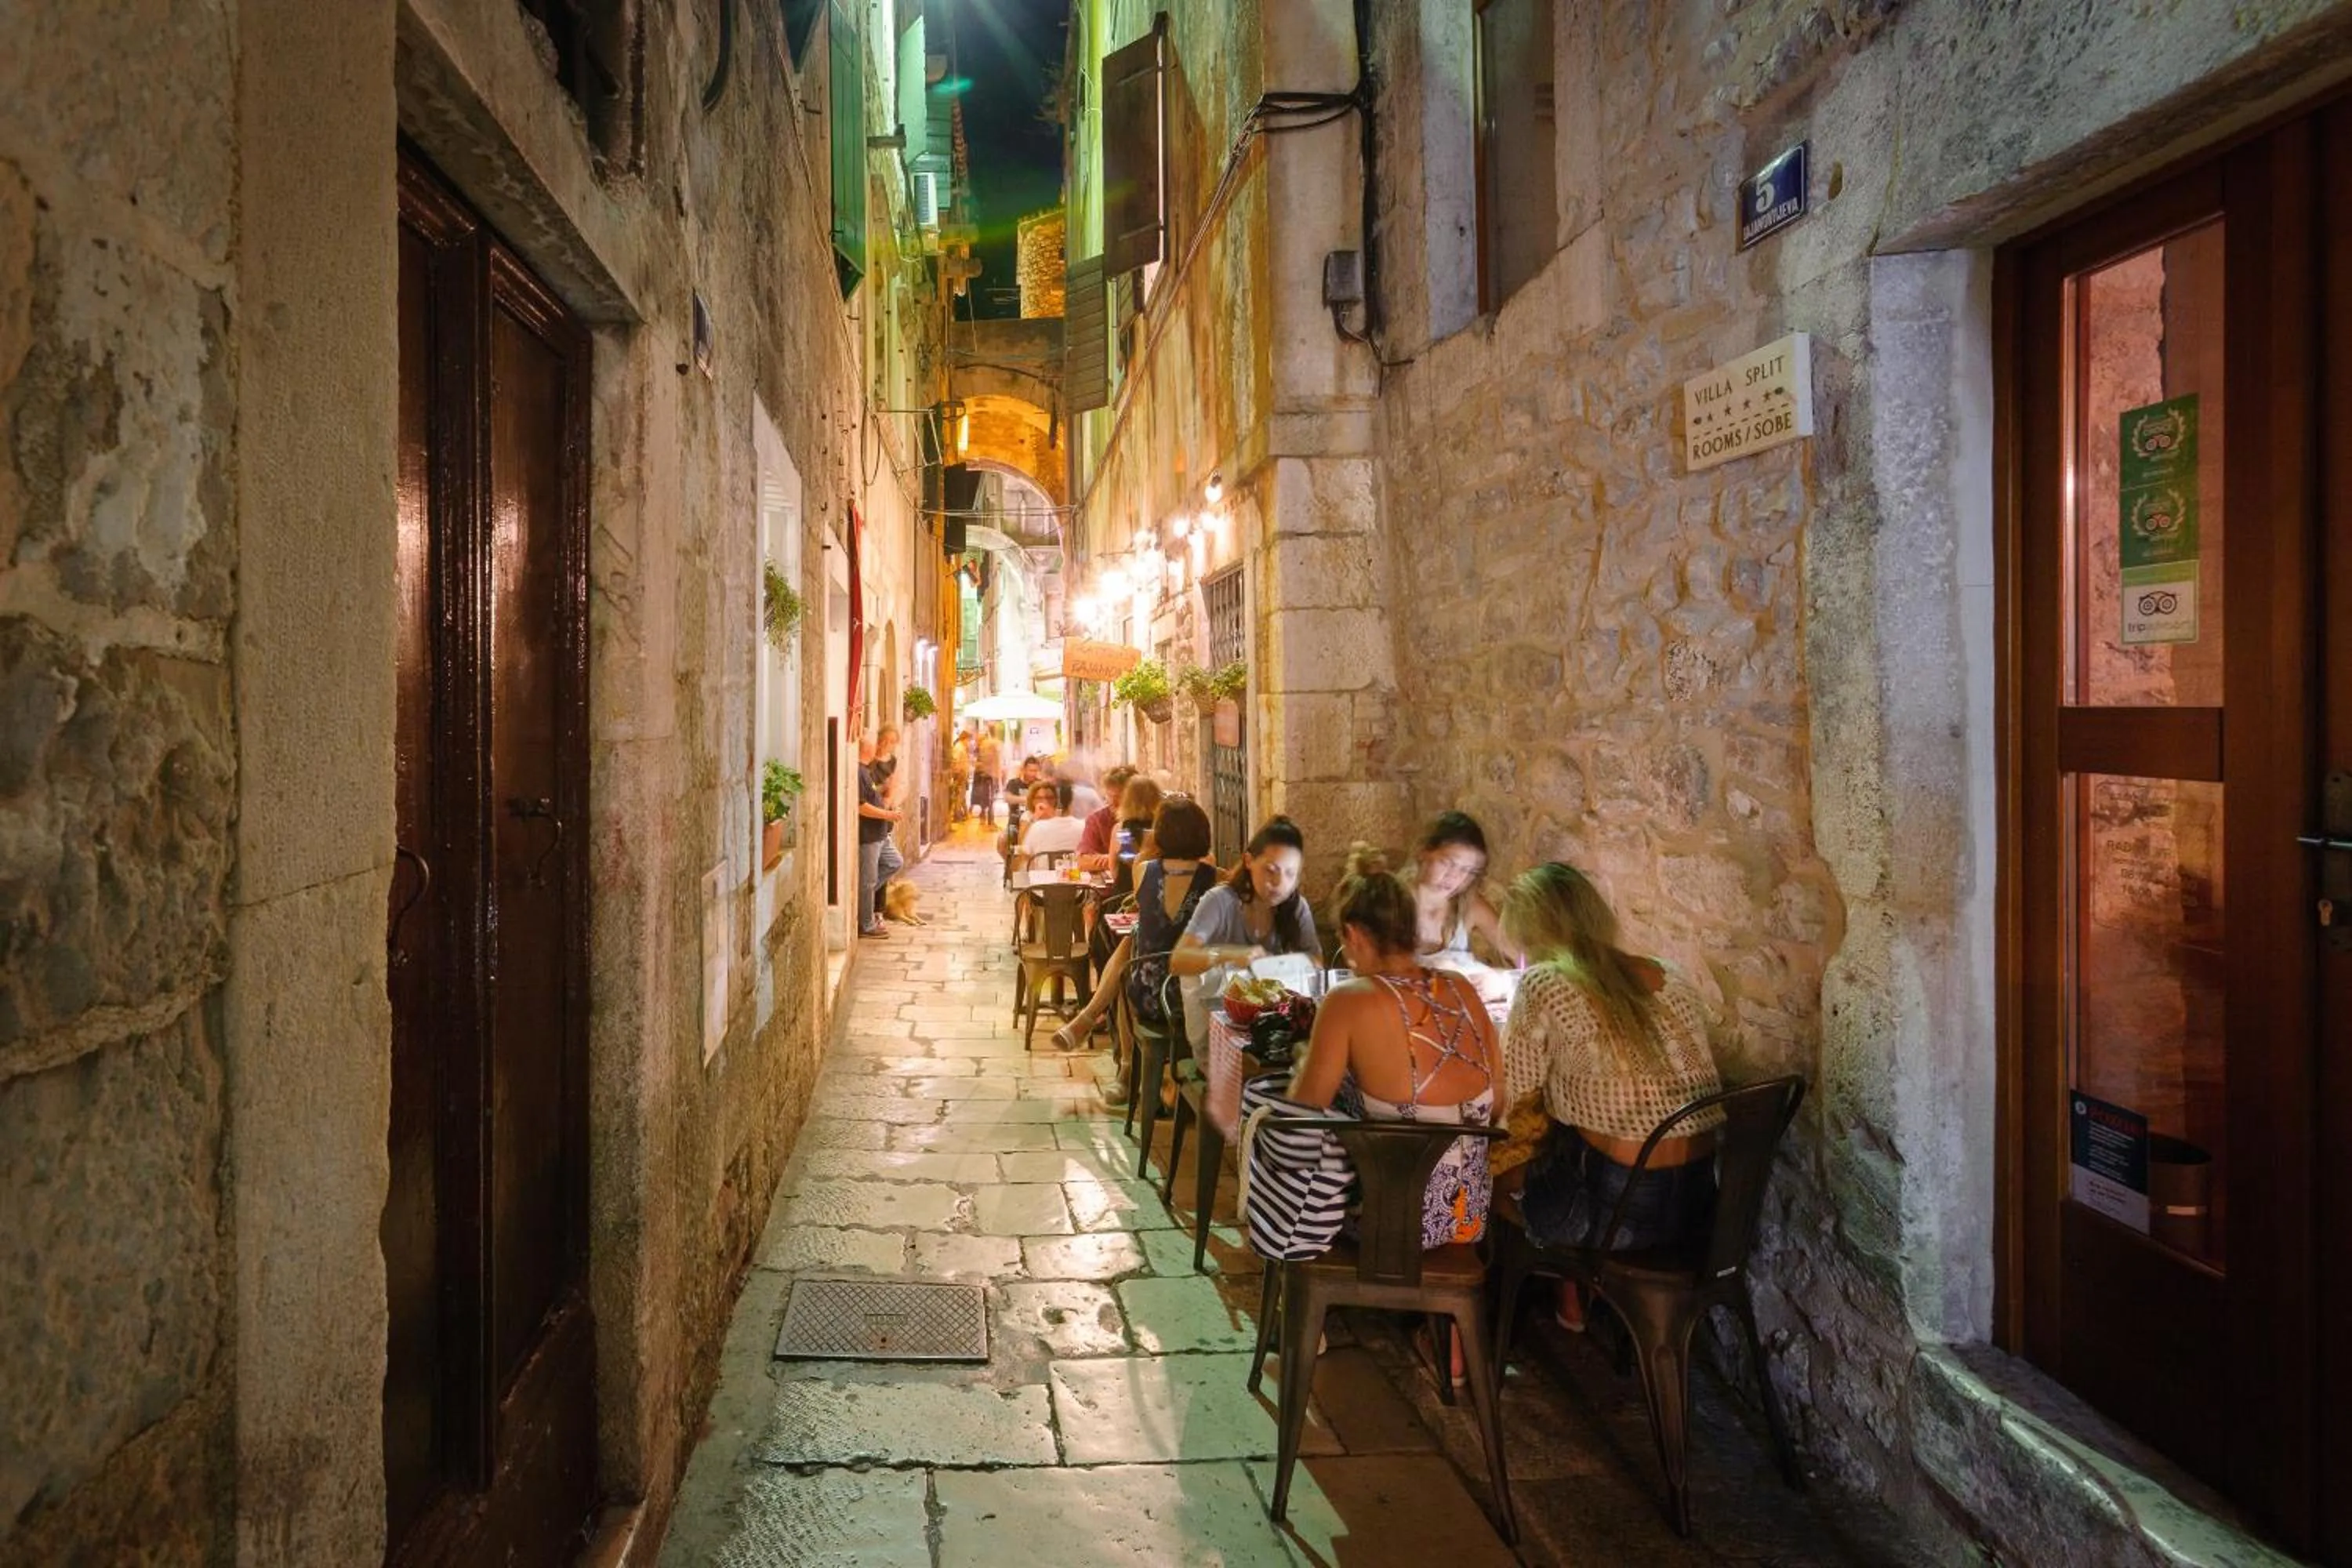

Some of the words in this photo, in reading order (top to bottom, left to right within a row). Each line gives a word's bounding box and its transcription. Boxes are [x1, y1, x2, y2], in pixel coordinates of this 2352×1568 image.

[1755, 169, 1774, 213] 5
[1694, 378, 1733, 406] VILLA
[1745, 354, 1785, 387] SPLIT
